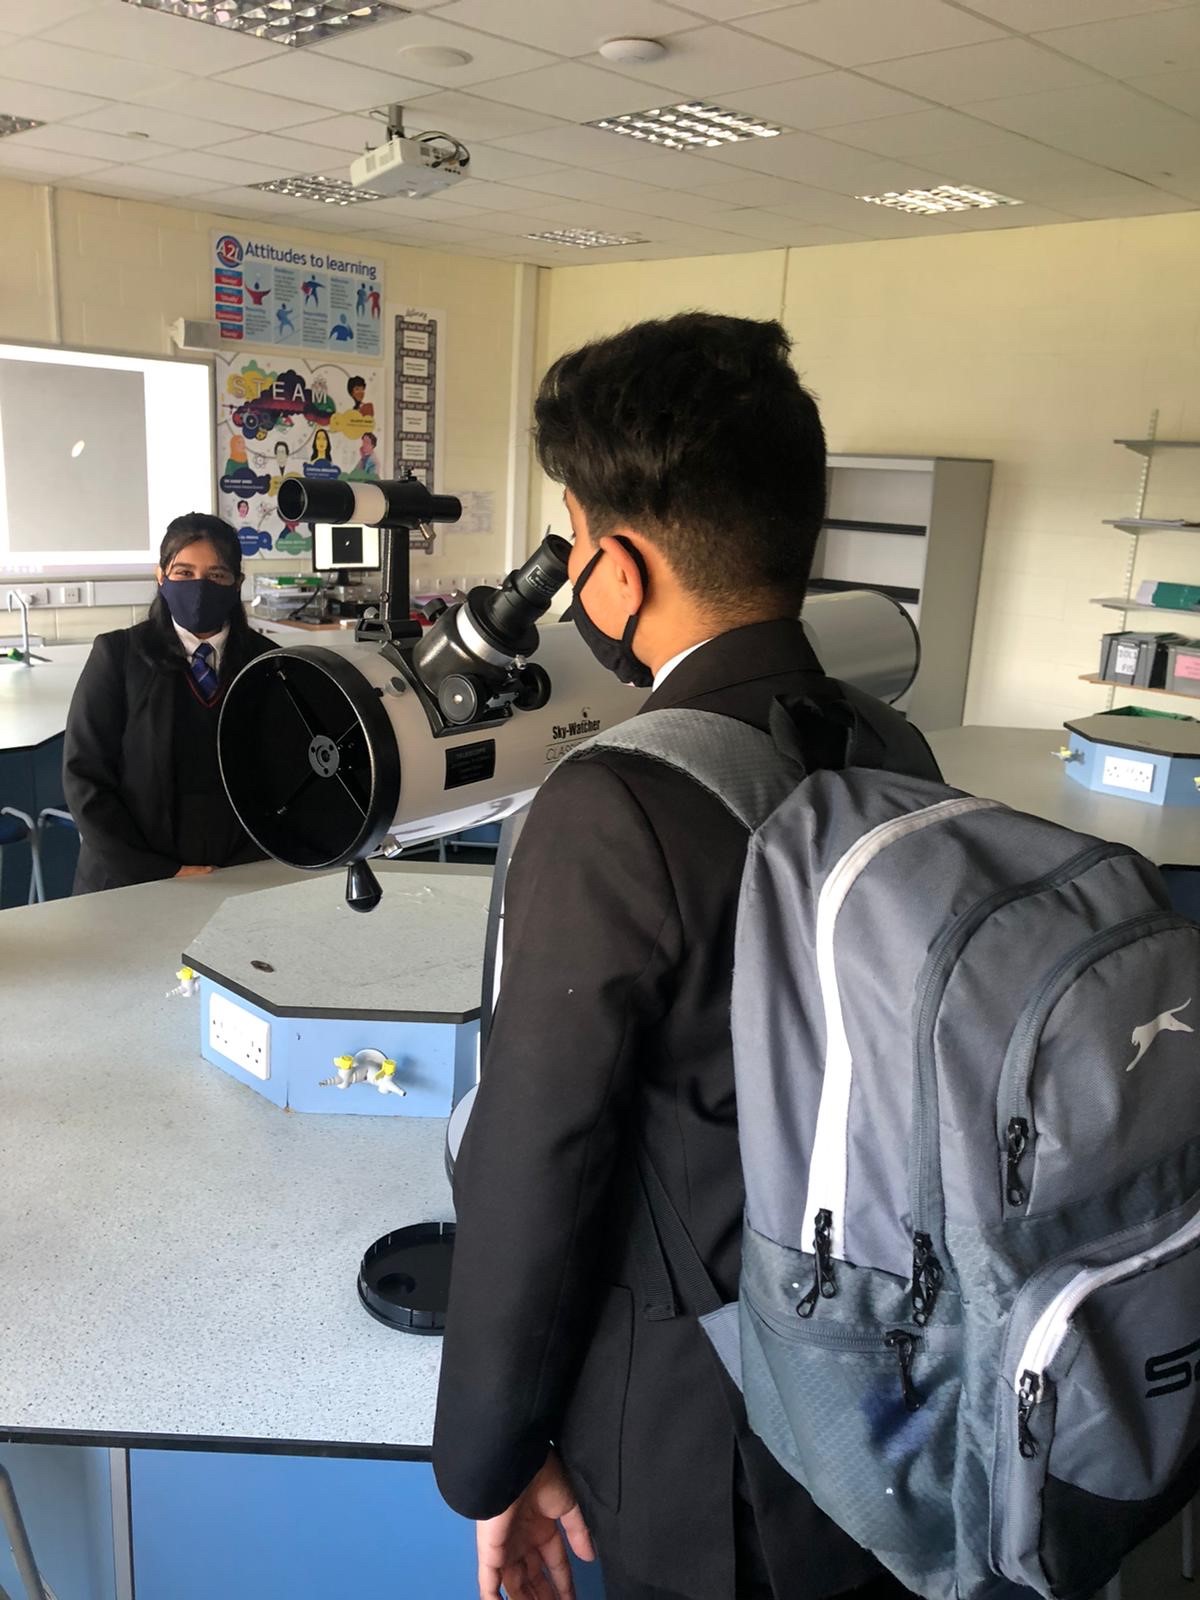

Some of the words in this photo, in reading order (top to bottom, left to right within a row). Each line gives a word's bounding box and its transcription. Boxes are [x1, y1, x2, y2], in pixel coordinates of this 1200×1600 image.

[246, 241, 307, 265] Attitudes
[310, 253, 324, 268] to
[327, 255, 377, 280] learning
[231, 375, 328, 404] STEAM
[552, 719, 601, 740] Sky-Watcher
[1144, 1337, 1200, 1399] S
